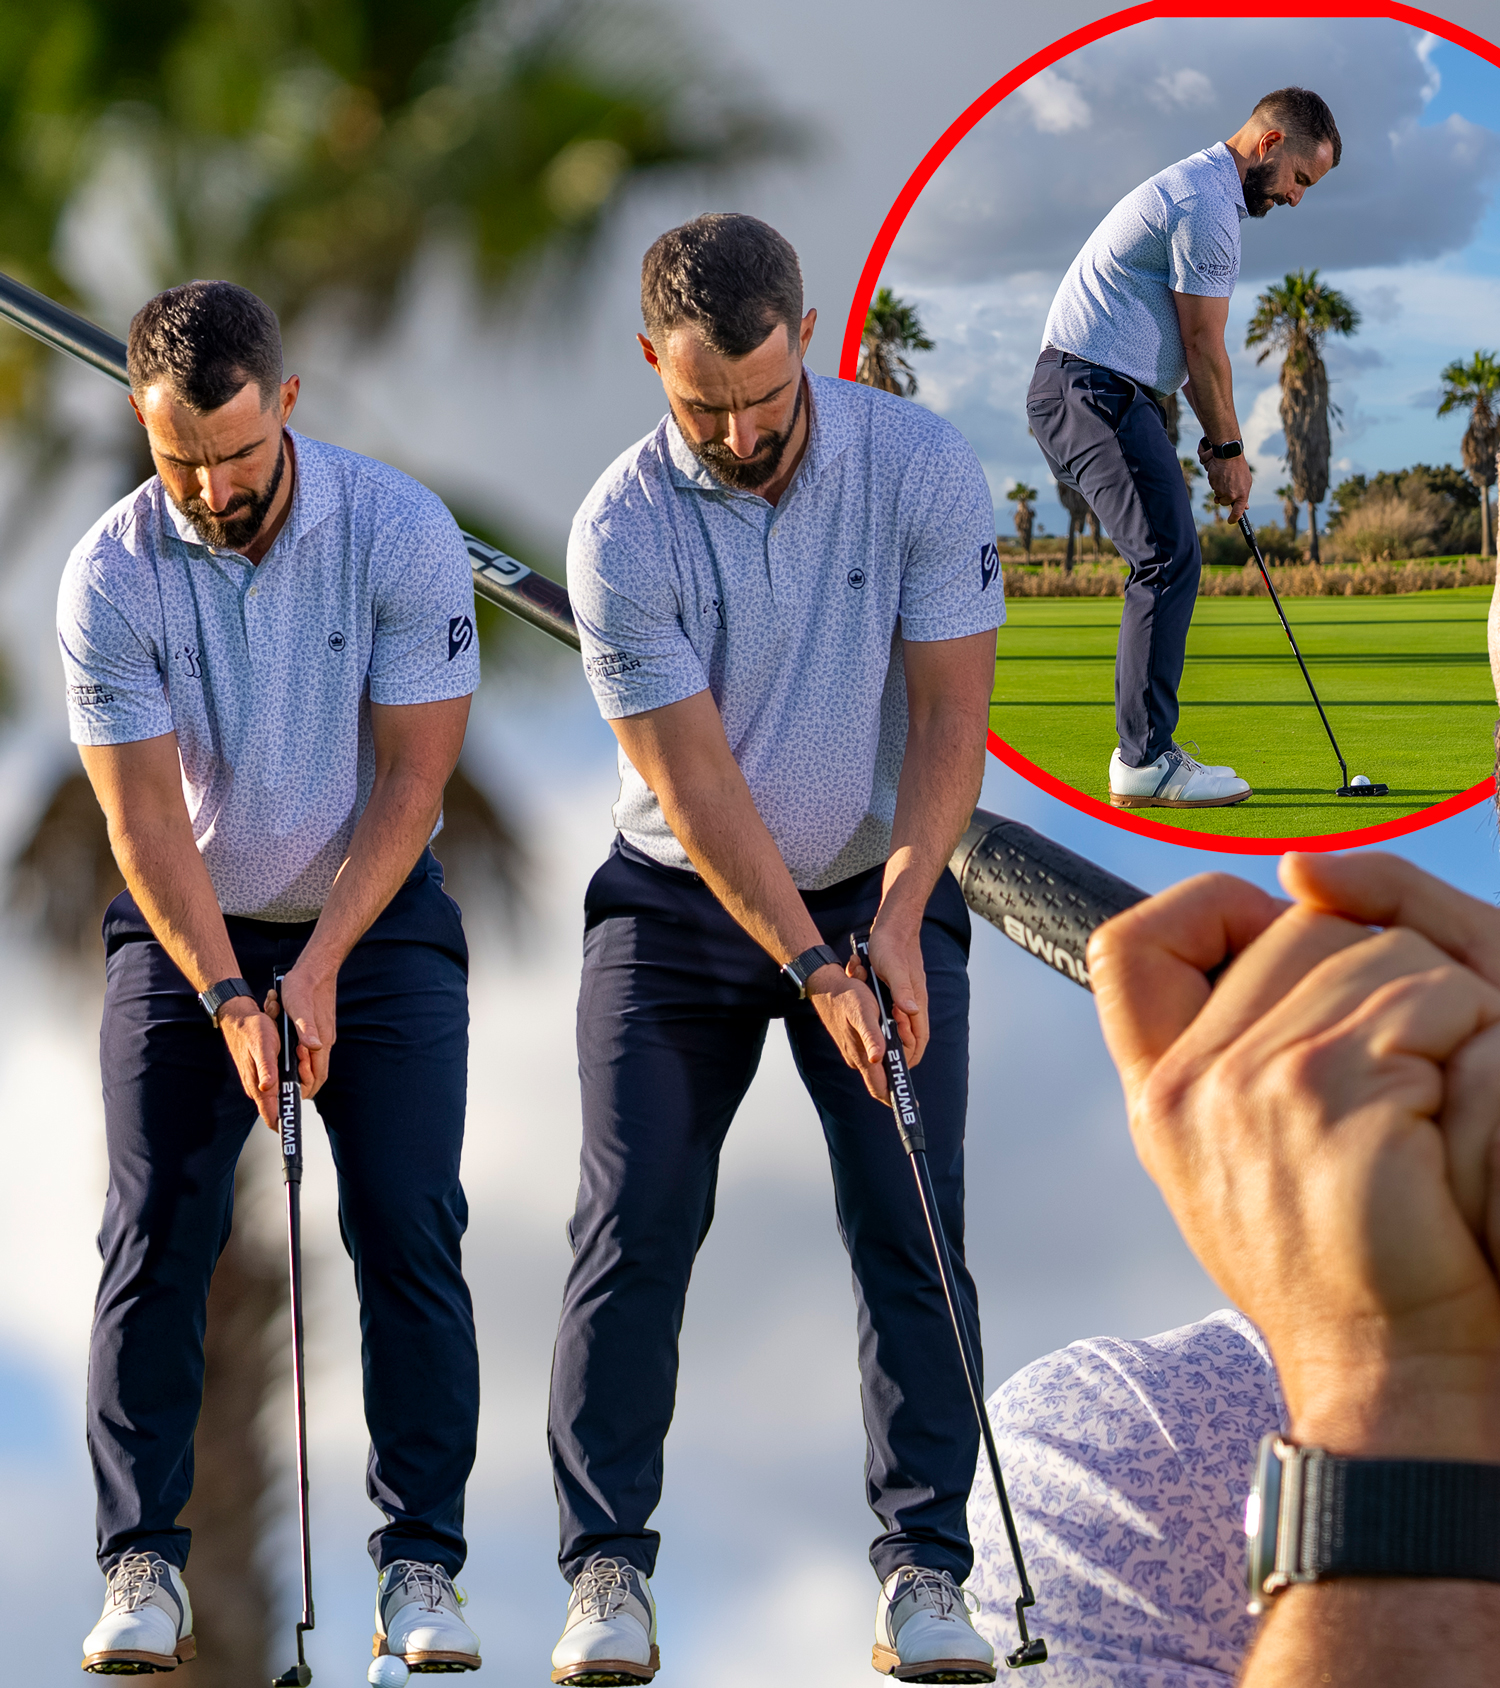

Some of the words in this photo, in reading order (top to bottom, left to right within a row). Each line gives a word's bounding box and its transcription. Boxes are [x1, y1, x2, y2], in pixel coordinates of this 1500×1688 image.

[592, 651, 629, 666] PETER
[593, 659, 642, 677] MILLAR
[887, 1049, 917, 1126] 2THUMB
[281, 1081, 297, 1156] 2THUMB
